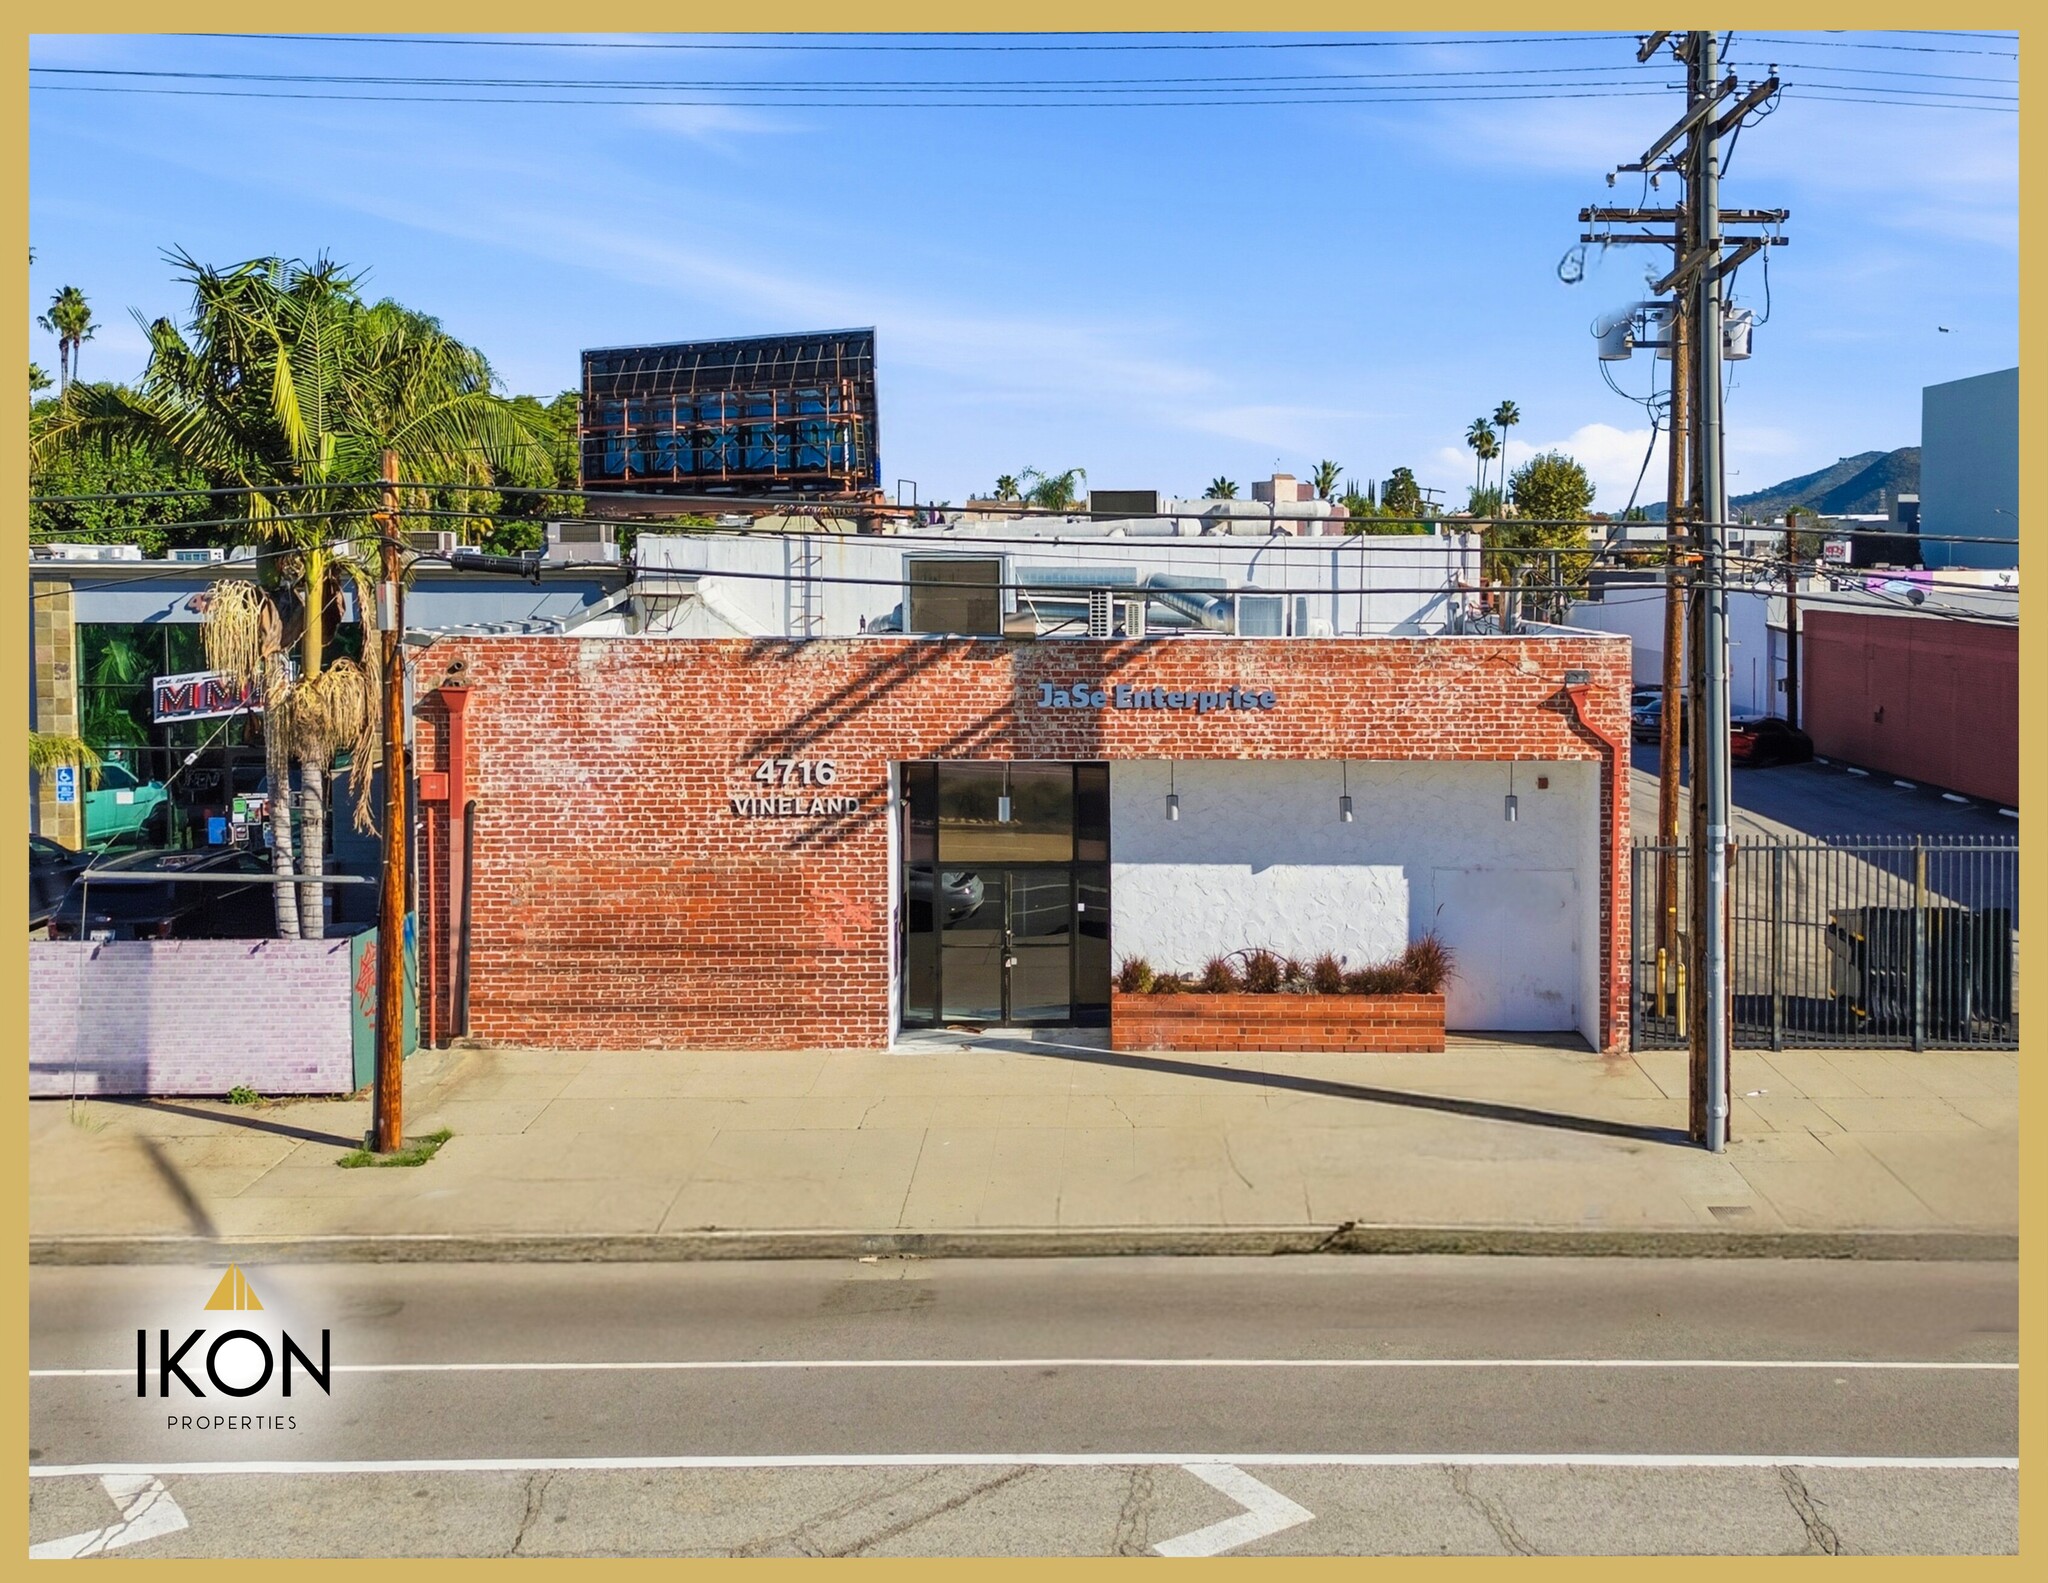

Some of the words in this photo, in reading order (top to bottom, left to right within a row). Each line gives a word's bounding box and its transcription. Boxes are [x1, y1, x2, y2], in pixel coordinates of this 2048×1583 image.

[1038, 683, 1106, 708] JaSe
[1115, 683, 1277, 712] Enterprise
[755, 759, 837, 785] 4716
[734, 797, 859, 815] VINELAND
